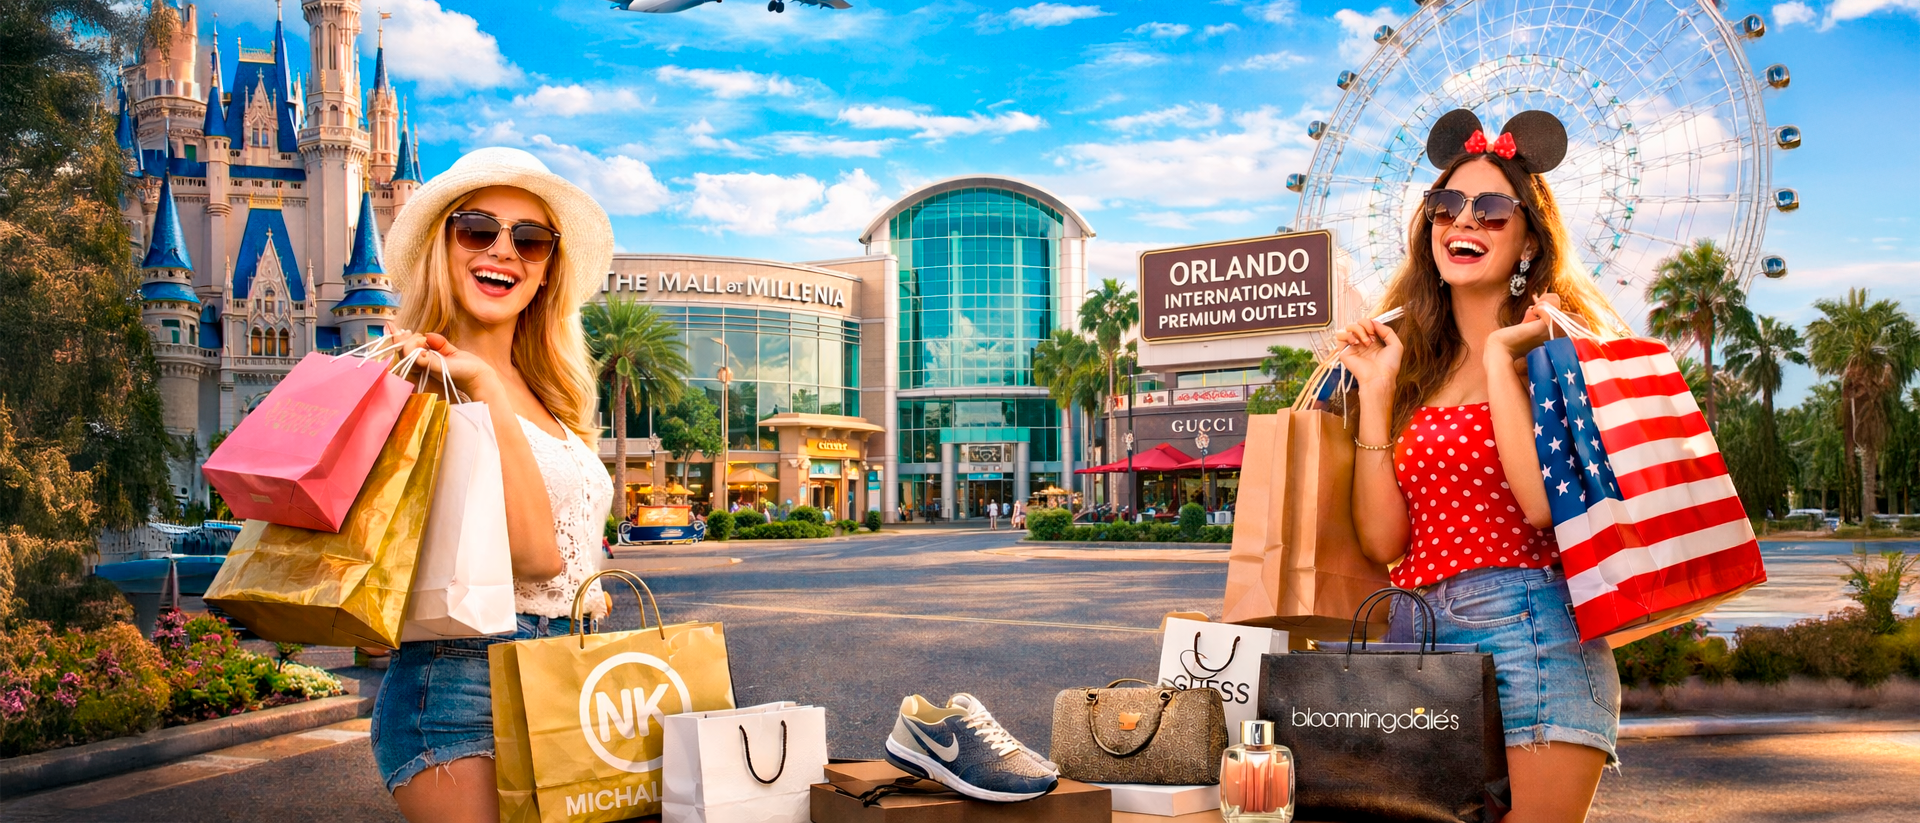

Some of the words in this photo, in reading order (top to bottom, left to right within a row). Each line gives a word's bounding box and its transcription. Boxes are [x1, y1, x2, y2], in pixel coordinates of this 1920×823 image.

[1169, 248, 1310, 286] ORLANDO
[602, 271, 648, 293] THE
[658, 271, 725, 294] MALL
[746, 274, 845, 308] MILLENIA
[1164, 280, 1311, 310] INTERNATIONAL
[1158, 309, 1236, 330] PREMIUM
[1241, 301, 1318, 322] OUTLETS
[1171, 417, 1234, 433] GUCCI
[595, 683, 669, 743] NK
